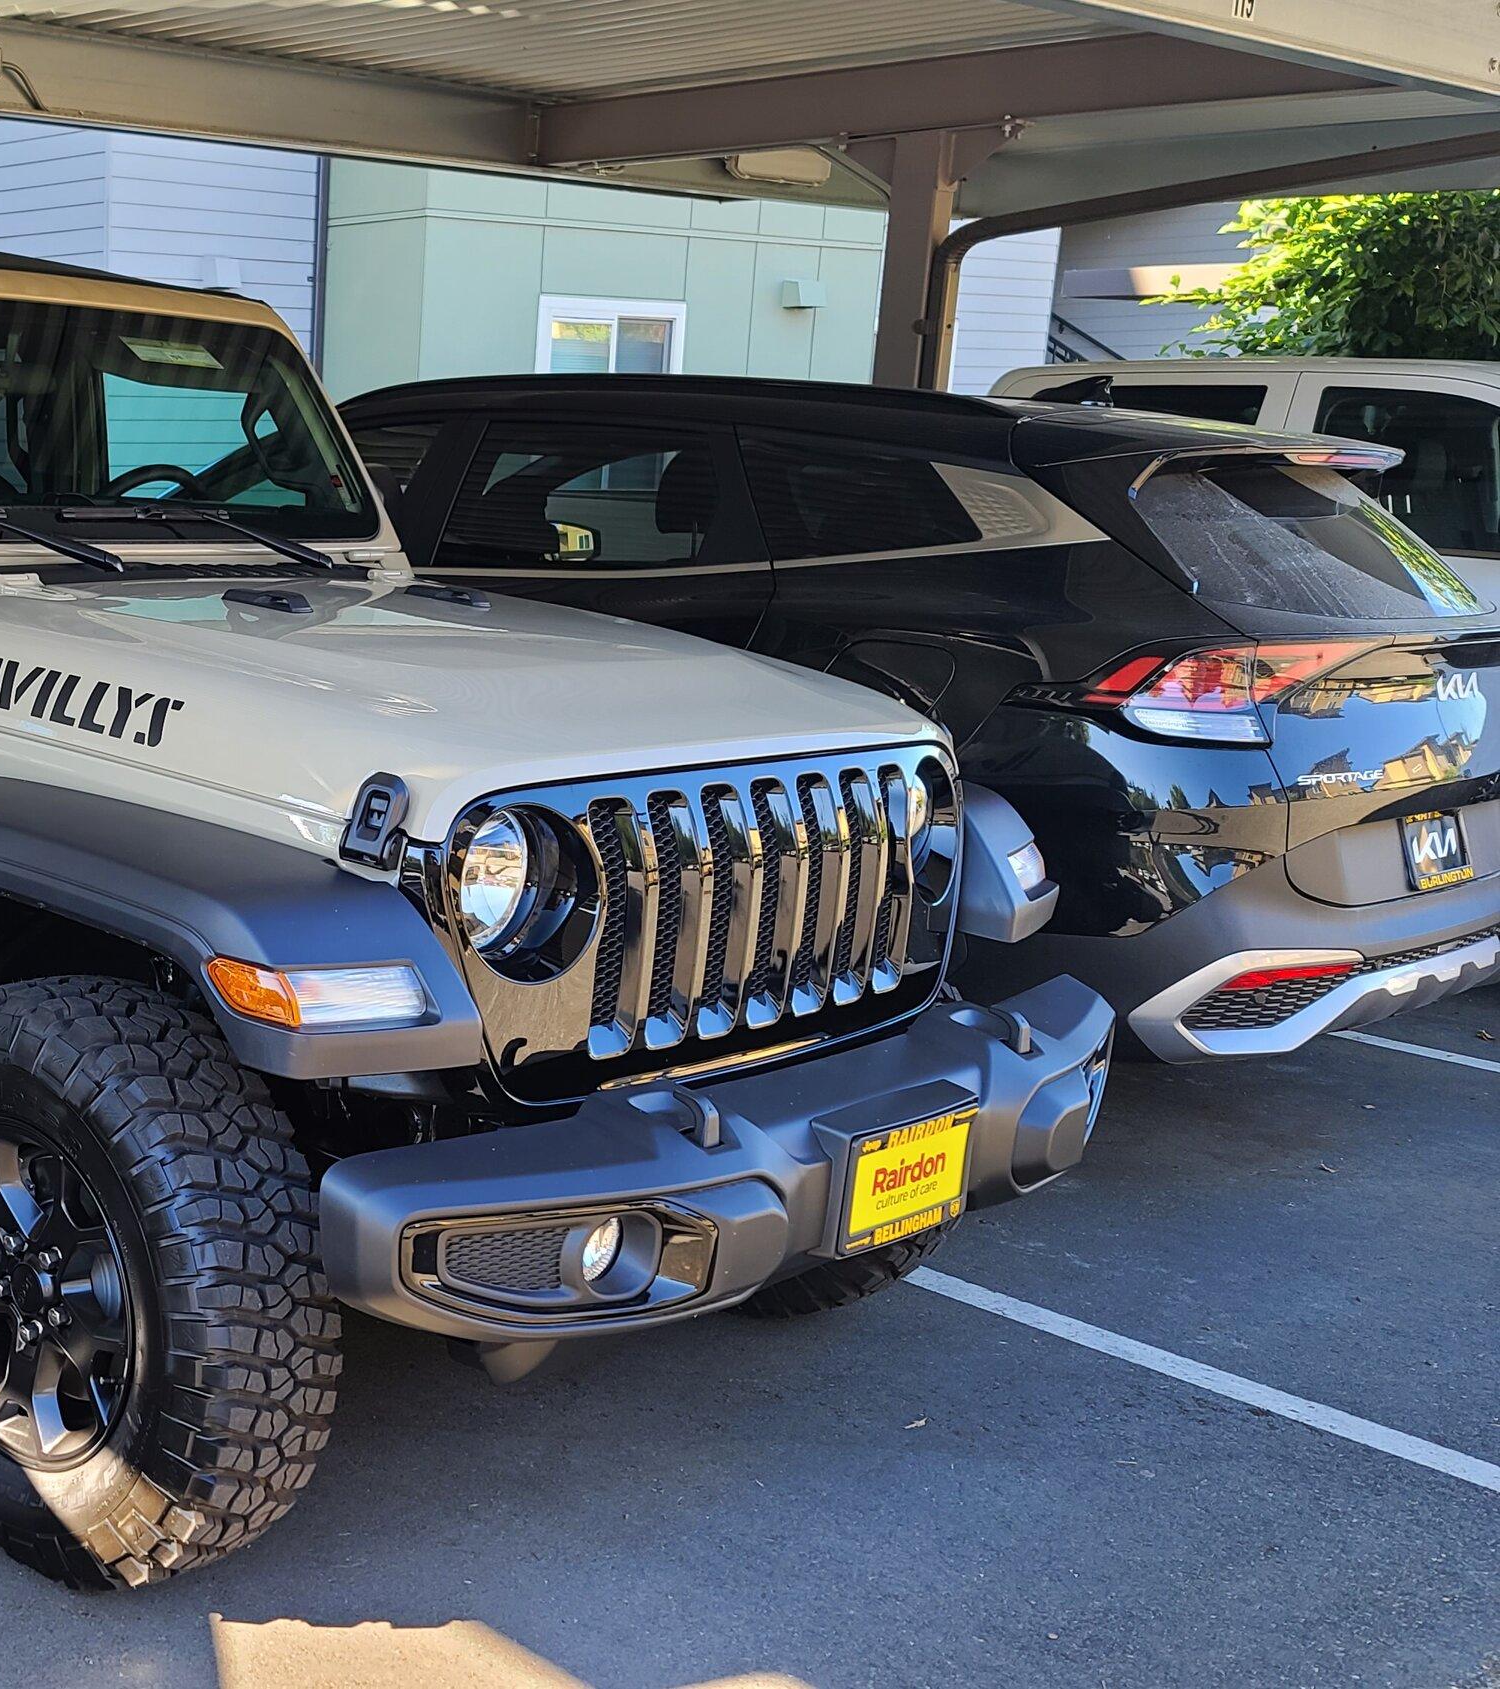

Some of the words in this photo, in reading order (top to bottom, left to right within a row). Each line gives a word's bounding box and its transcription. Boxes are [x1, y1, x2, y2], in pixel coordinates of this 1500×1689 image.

[1297, 769, 1385, 786] SPORTAGE
[887, 1113, 956, 1150] RAIRDON
[872, 1152, 947, 1197] Rairdon
[875, 1190, 913, 1211] culture
[909, 1185, 920, 1200] of
[919, 1180, 938, 1195] care
[873, 1206, 943, 1246] BELLINGHAM
